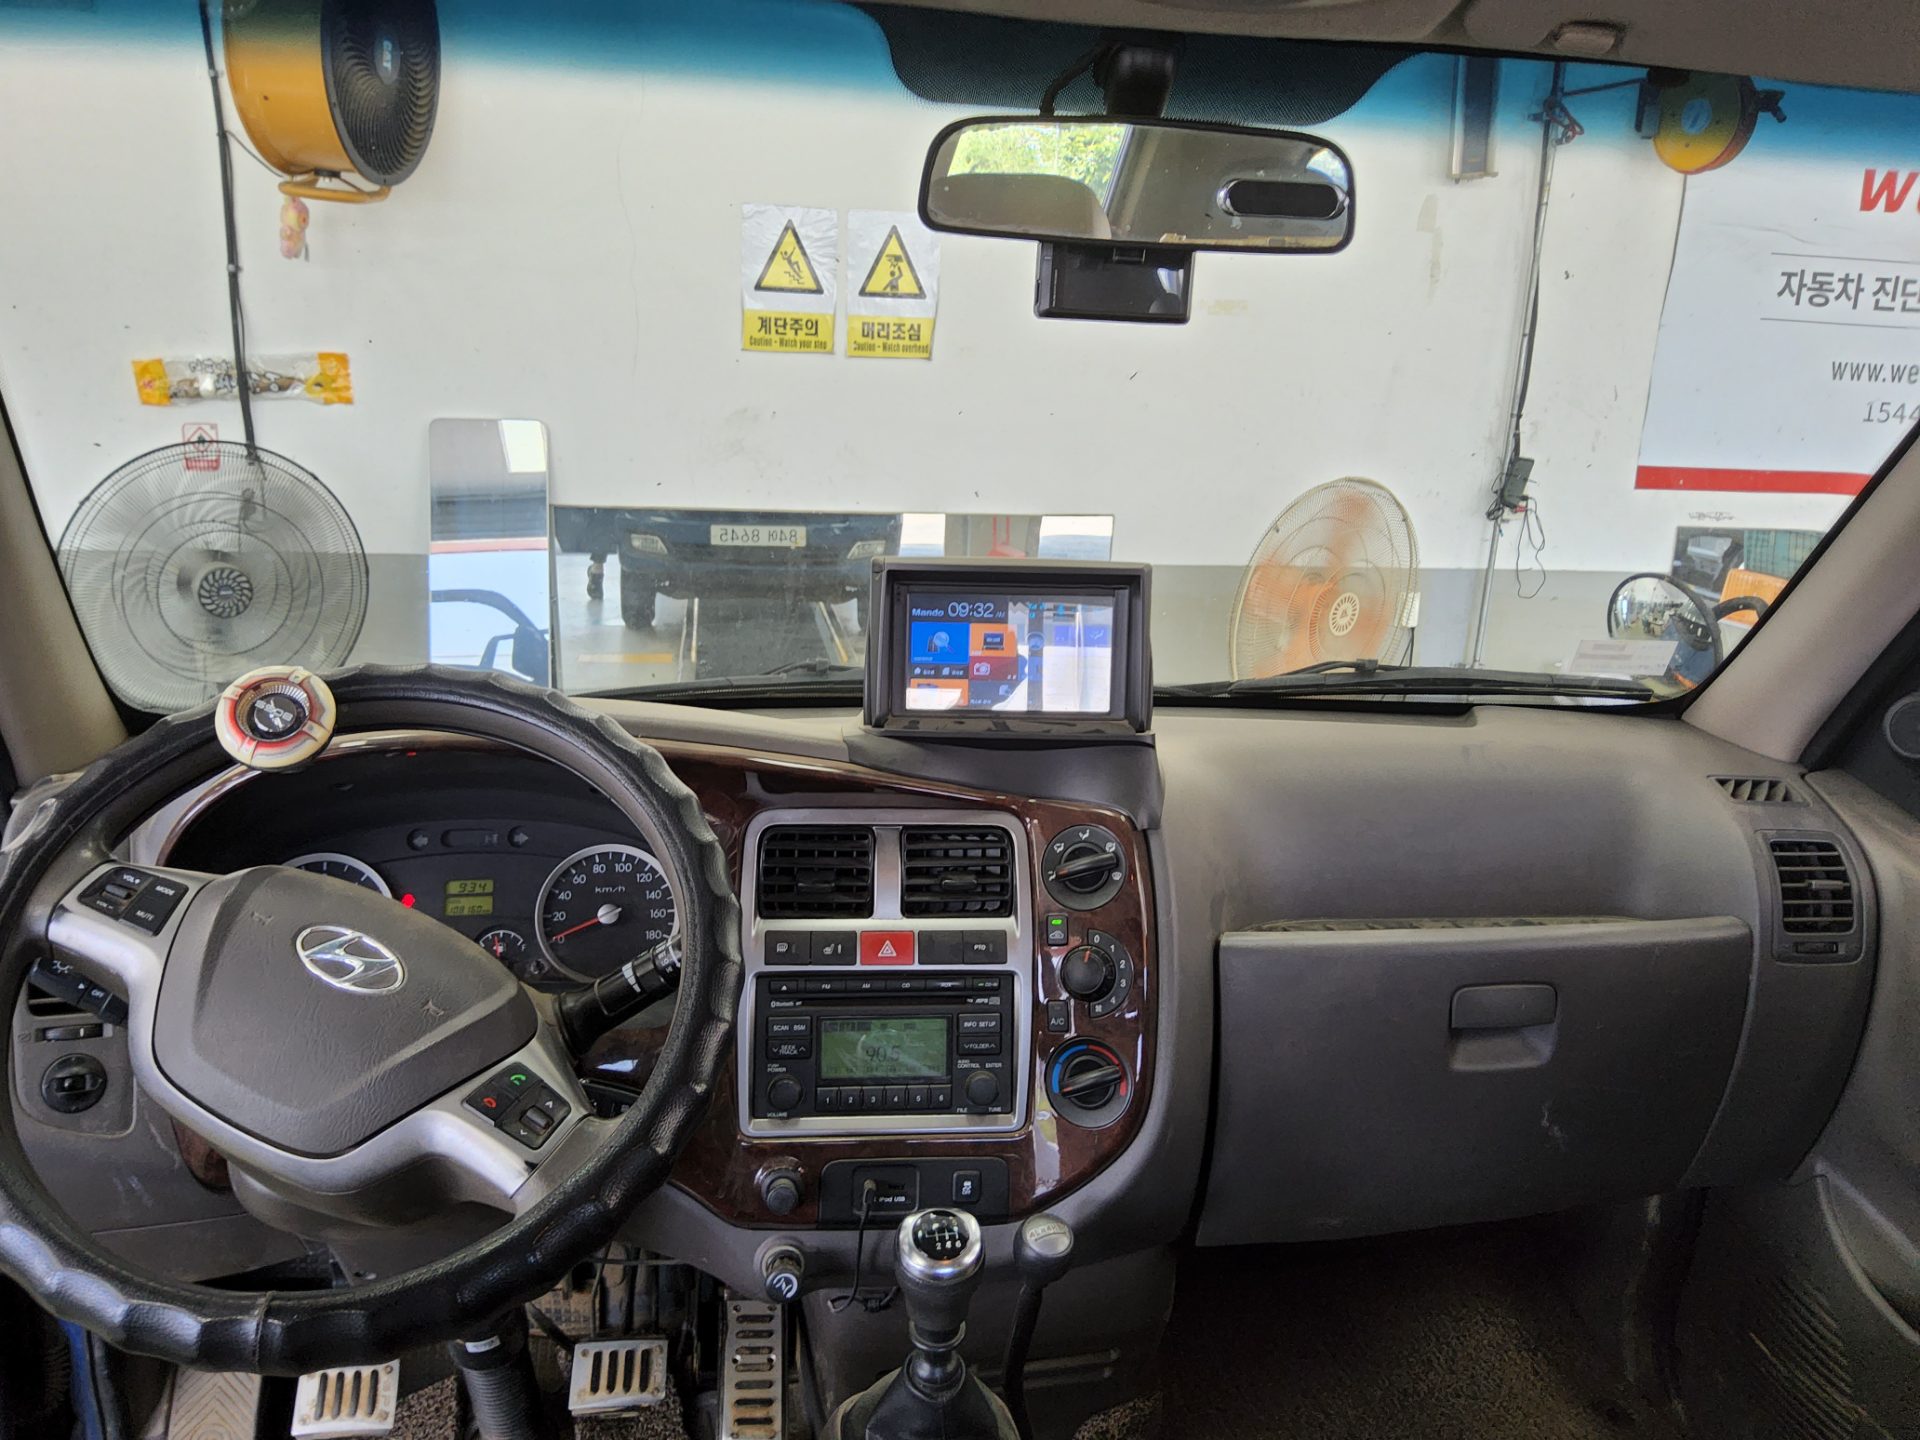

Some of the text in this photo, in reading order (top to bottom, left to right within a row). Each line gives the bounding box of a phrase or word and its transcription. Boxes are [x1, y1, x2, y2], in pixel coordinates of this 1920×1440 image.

[1777, 269, 1864, 310] 자동차
[758, 316, 819, 337] 계단주의
[861, 321, 921, 341] 머리조심
[750, 336, 772, 347] Caution
[779, 338, 797, 349] Watch
[799, 340, 813, 350] your
[814, 340, 827, 350] step
[882, 342, 900, 353] Watch
[901, 343, 929, 354] overhead
[1862, 401, 1920, 425] 1544
[911, 608, 944, 617] Mando
[948, 602, 995, 618] 09:32
[592, 864, 607, 873] 80
[614, 862, 632, 873] 100
[572, 874, 587, 884] 60
[636, 873, 653, 882] 120
[155, 885, 175, 897] MODE
[595, 885, 626, 894] km/h
[558, 891, 572, 900] 40
[645, 890, 662, 900] 140
[135, 910, 155, 921] MUTE
[552, 911, 566, 921] 20
[650, 909, 667, 918] 160
[557, 934, 565, 944] 0
[645, 930, 662, 940] 180
[1094, 935, 1100, 943] 0
[973, 943, 987, 951] PTO
[1110, 944, 1115, 952] 1
[1119, 960, 1126, 969] 2
[1120, 979, 1126, 987] 3
[91, 988, 105, 998] OFF
[1110, 996, 1116, 1004] 4
[1050, 1017, 1065, 1026] A/C
[866, 1045, 900, 1061] 90.5
[938, 1094, 944, 1102] 6
[936, 1242, 941, 1250] 2
[945, 1240, 952, 1248] 4
[955, 1240, 961, 1248] 6
